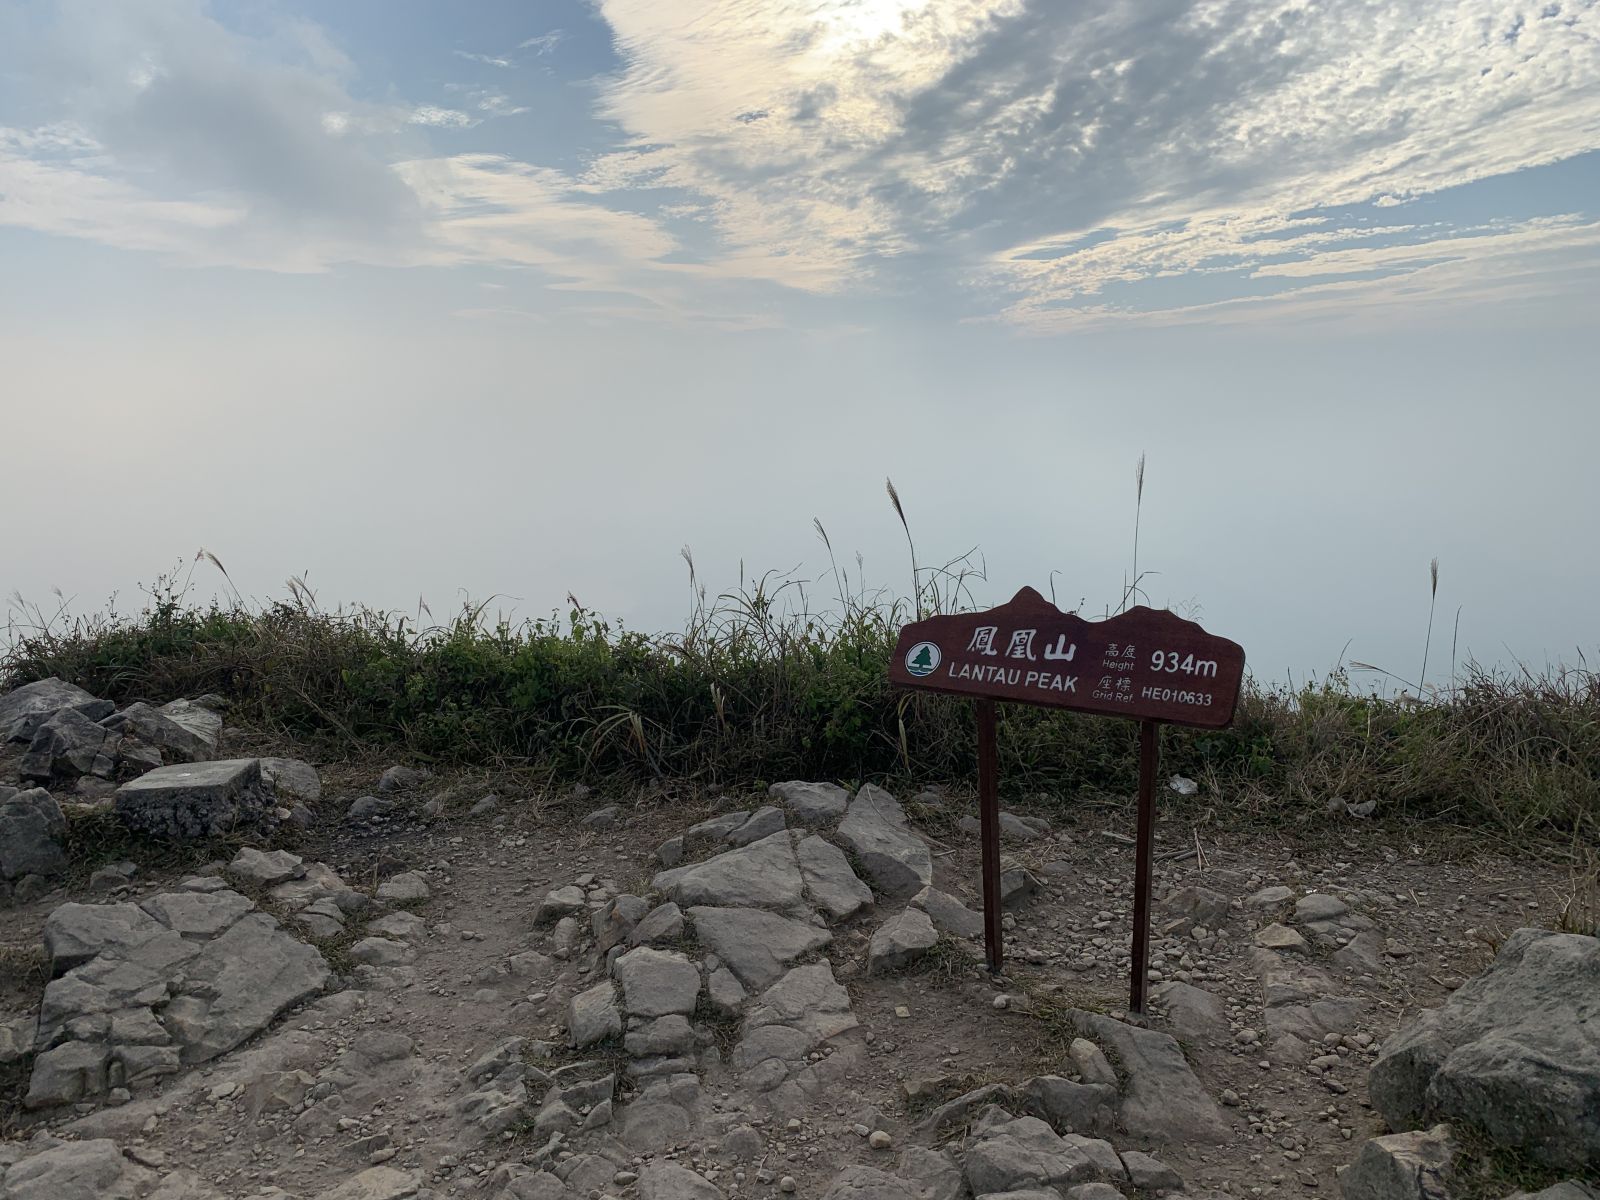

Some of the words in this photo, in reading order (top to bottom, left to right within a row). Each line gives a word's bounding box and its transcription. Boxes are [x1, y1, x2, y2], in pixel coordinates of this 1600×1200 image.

[966, 625, 1077, 661] 鳳凰山
[1105, 643, 1136, 659] 高度
[1102, 659, 1135, 672] Height
[1149, 649, 1218, 678] 934m
[948, 661, 1021, 685] LANTAU
[1024, 671, 1079, 693] PEAK
[1097, 675, 1132, 692] 座標
[1092, 690, 1114, 700] Grid
[1141, 686, 1213, 706] HE010633
